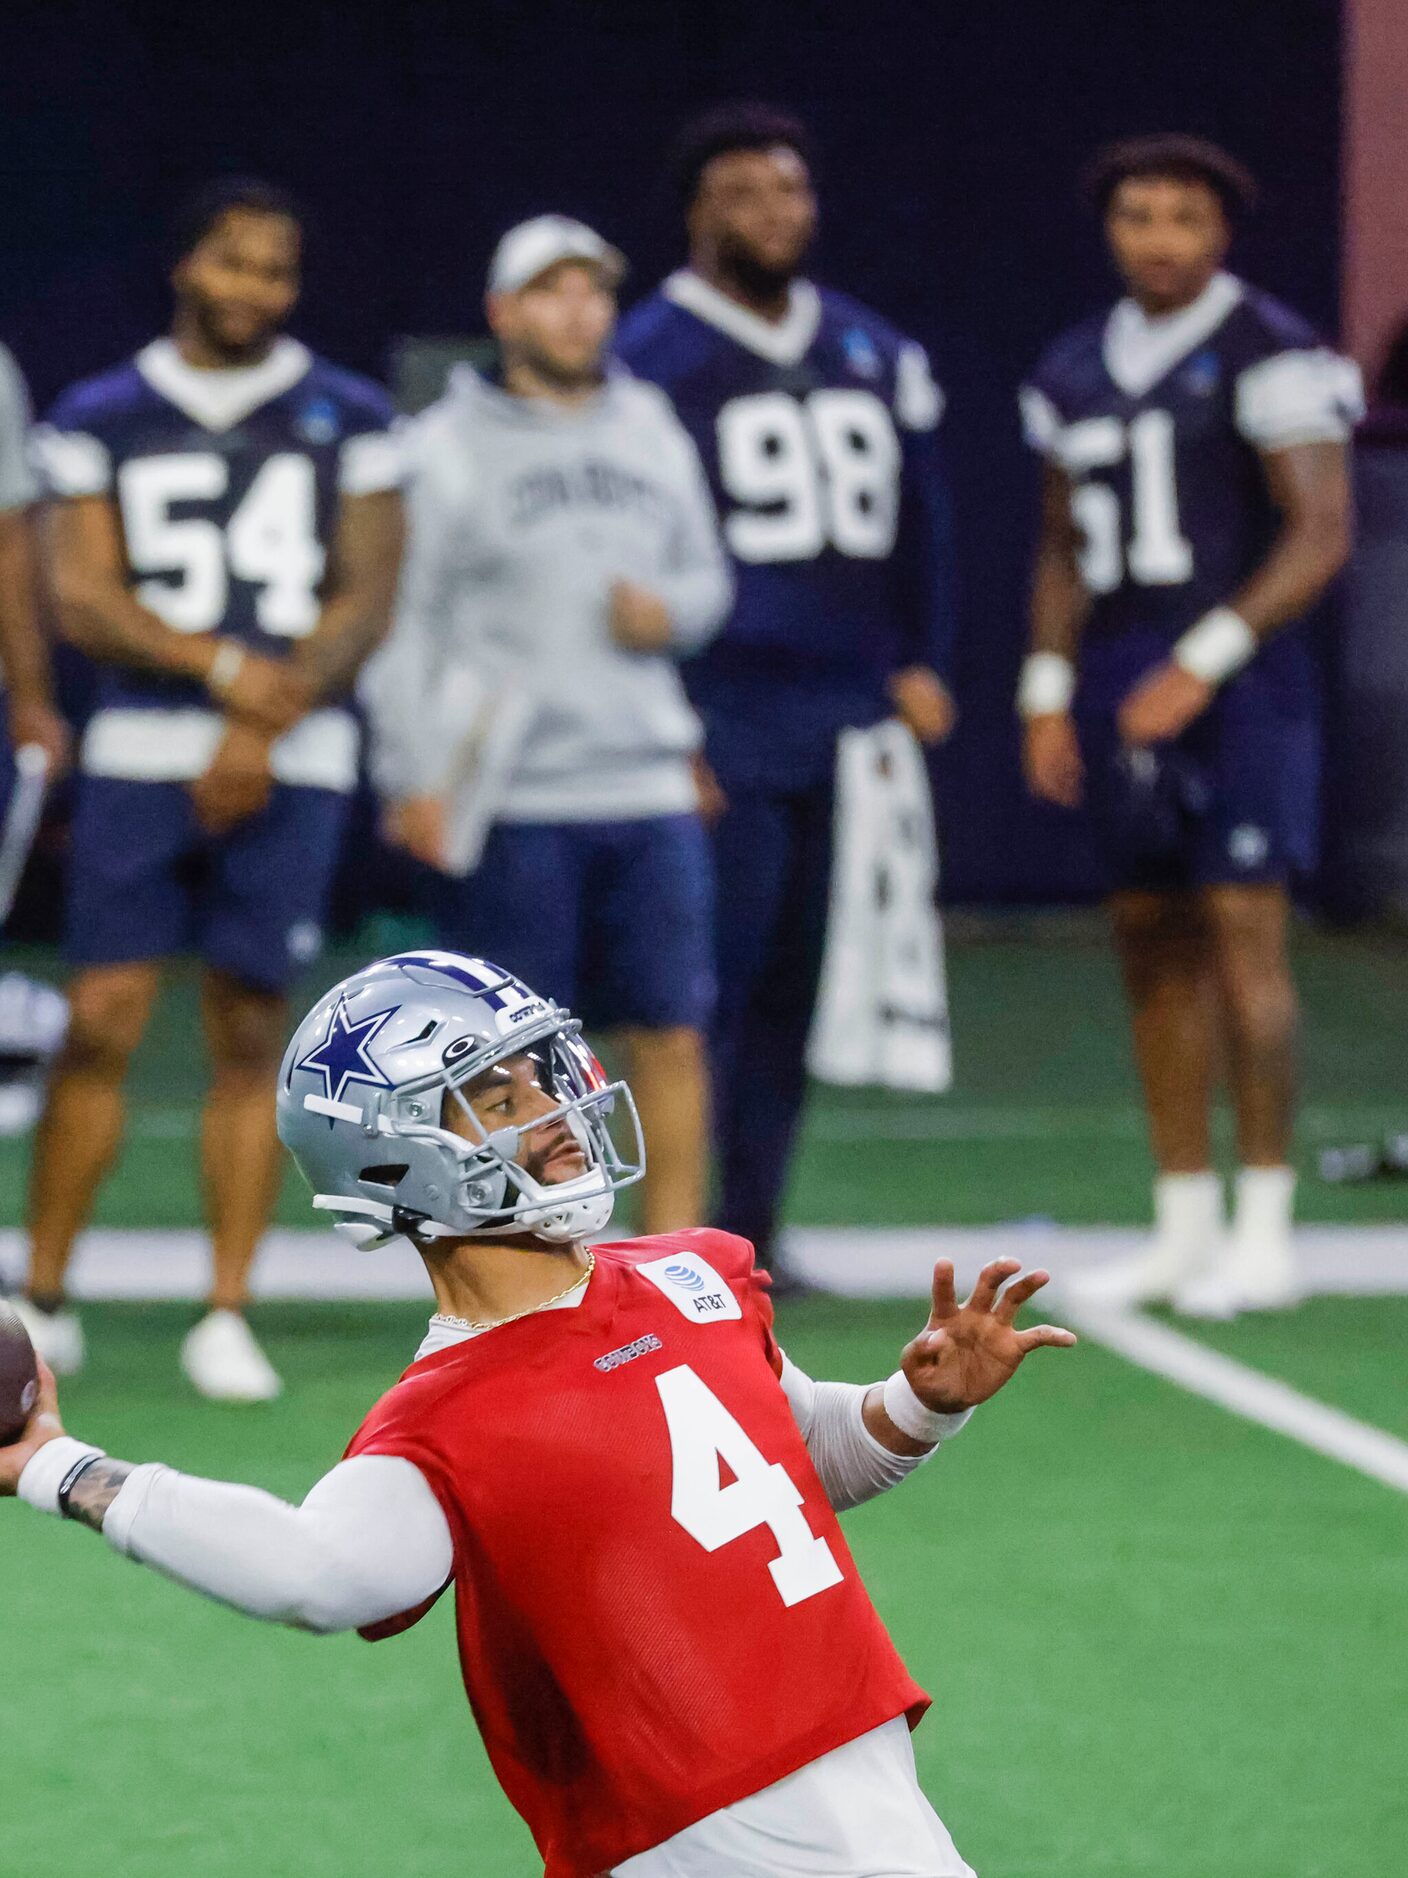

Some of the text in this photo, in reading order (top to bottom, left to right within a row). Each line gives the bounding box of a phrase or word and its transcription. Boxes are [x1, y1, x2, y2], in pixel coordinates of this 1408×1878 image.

[118, 452, 327, 639] 54
[718, 388, 902, 563] 98
[593, 1333, 663, 1373] COWBOYS
[693, 1294, 726, 1313] AT&T
[655, 1364, 844, 1607] 4
